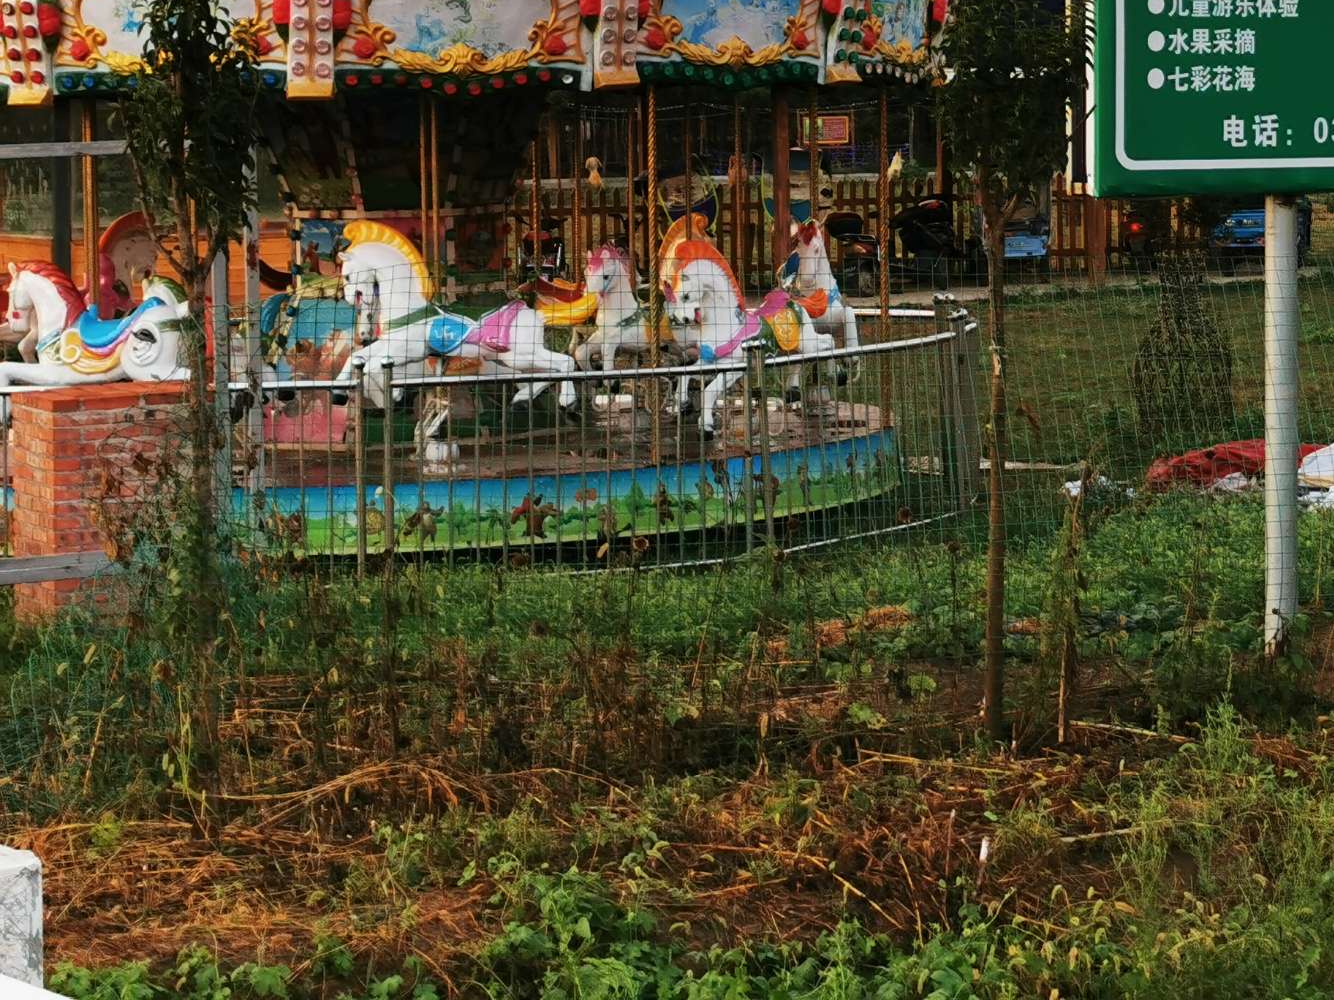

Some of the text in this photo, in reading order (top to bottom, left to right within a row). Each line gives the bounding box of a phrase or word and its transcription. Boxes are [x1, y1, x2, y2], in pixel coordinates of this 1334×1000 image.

[1168, 28, 1256, 55] 水果采摘
[1167, 65, 1256, 92] 七彩花海
